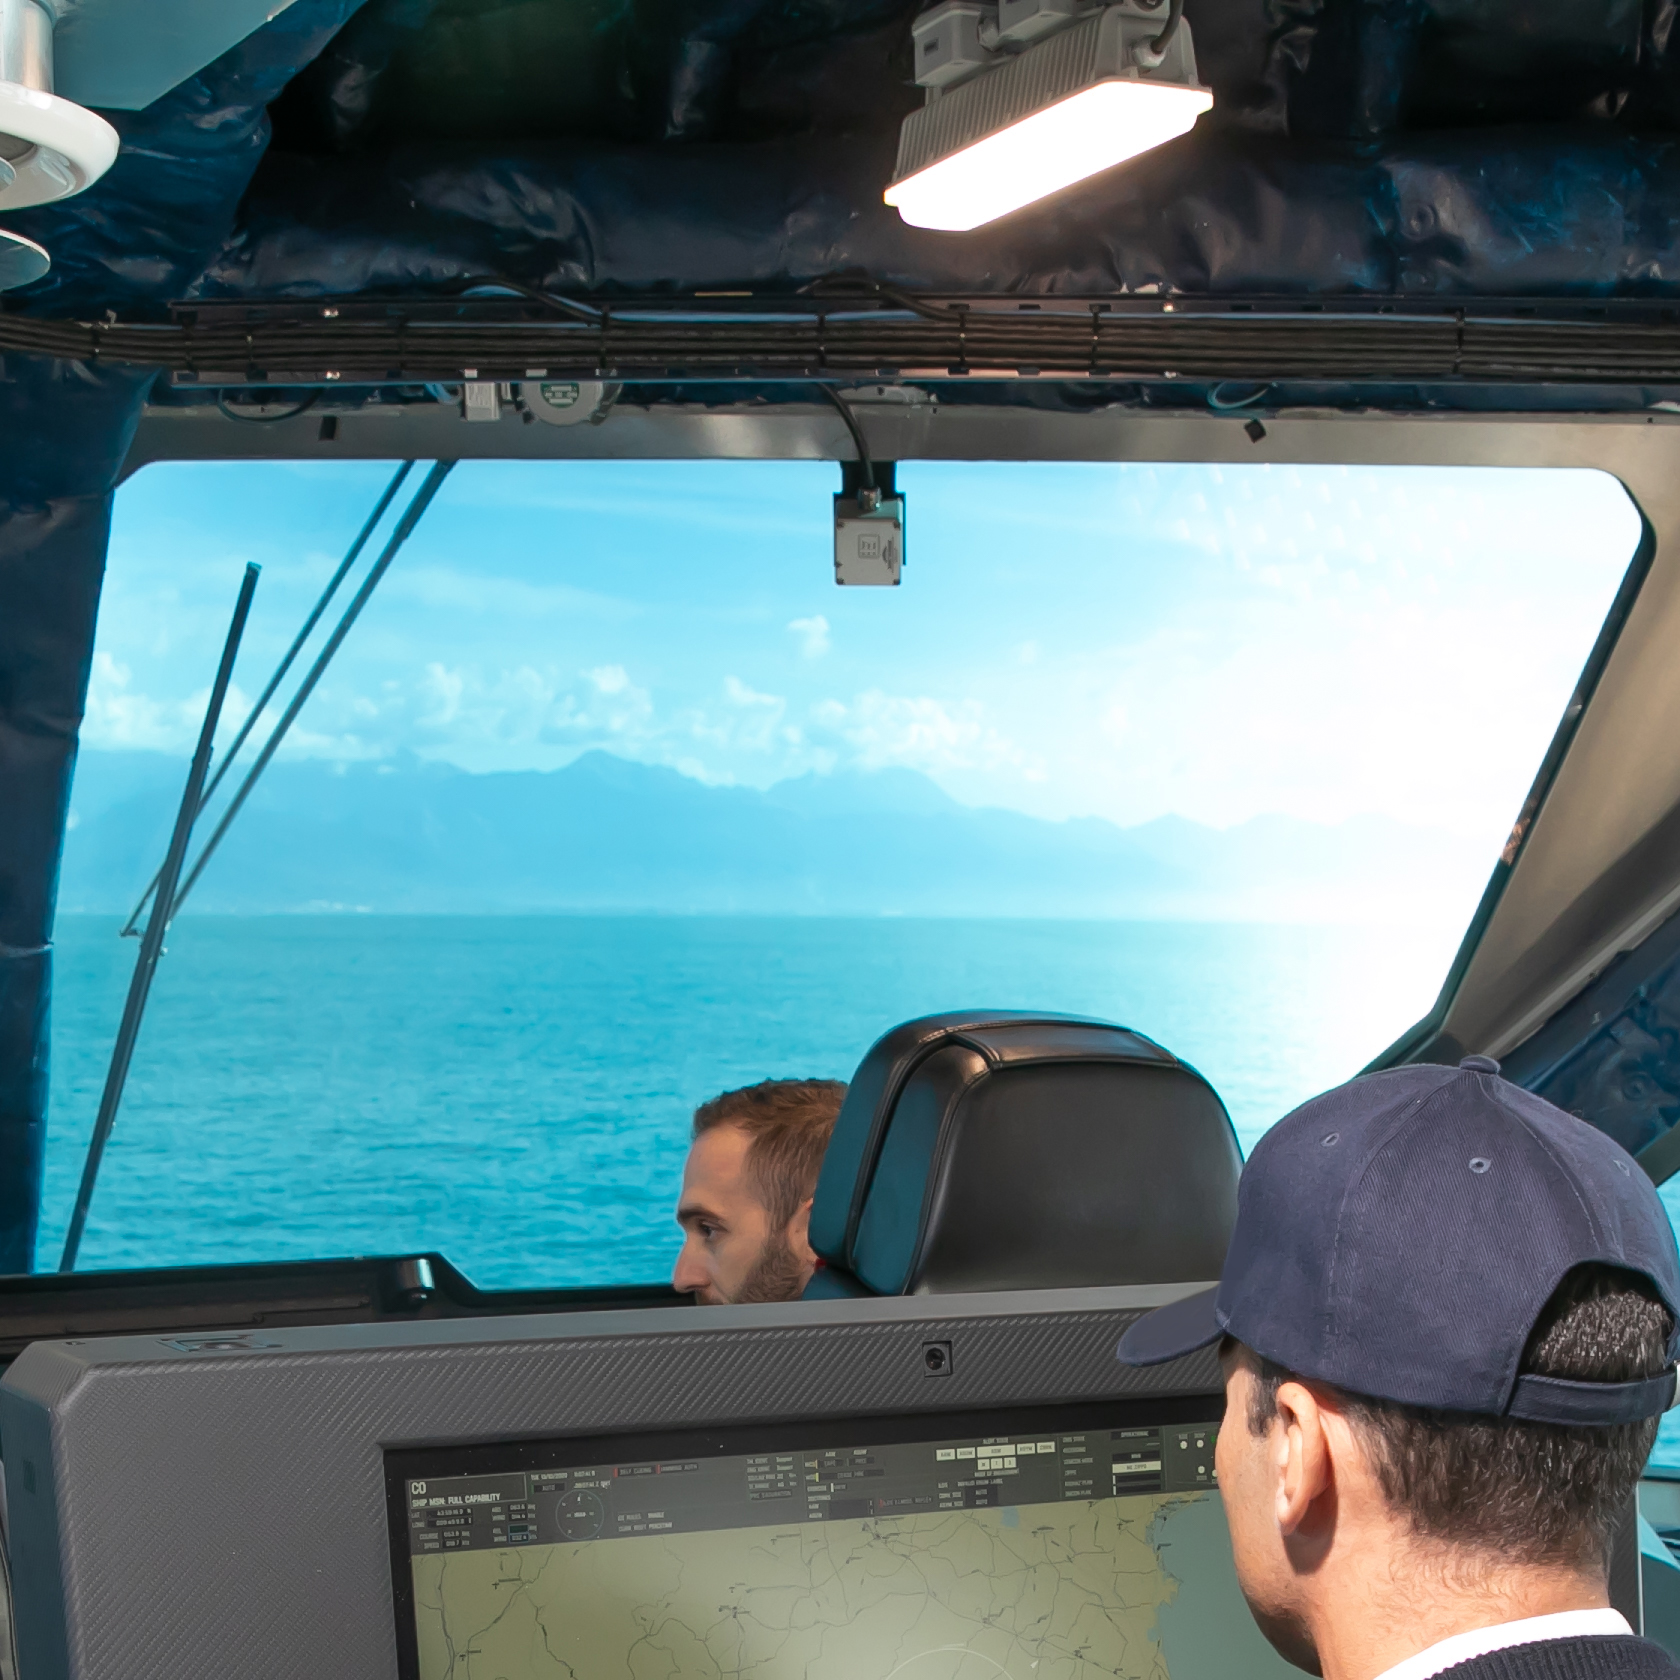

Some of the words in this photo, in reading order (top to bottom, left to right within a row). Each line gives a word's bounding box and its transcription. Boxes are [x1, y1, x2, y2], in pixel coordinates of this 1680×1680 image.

[412, 1482, 426, 1494] CO
[412, 1498, 427, 1507] SHIP
[448, 1496, 463, 1504] FULL
[465, 1493, 501, 1503] CAPABILITY
